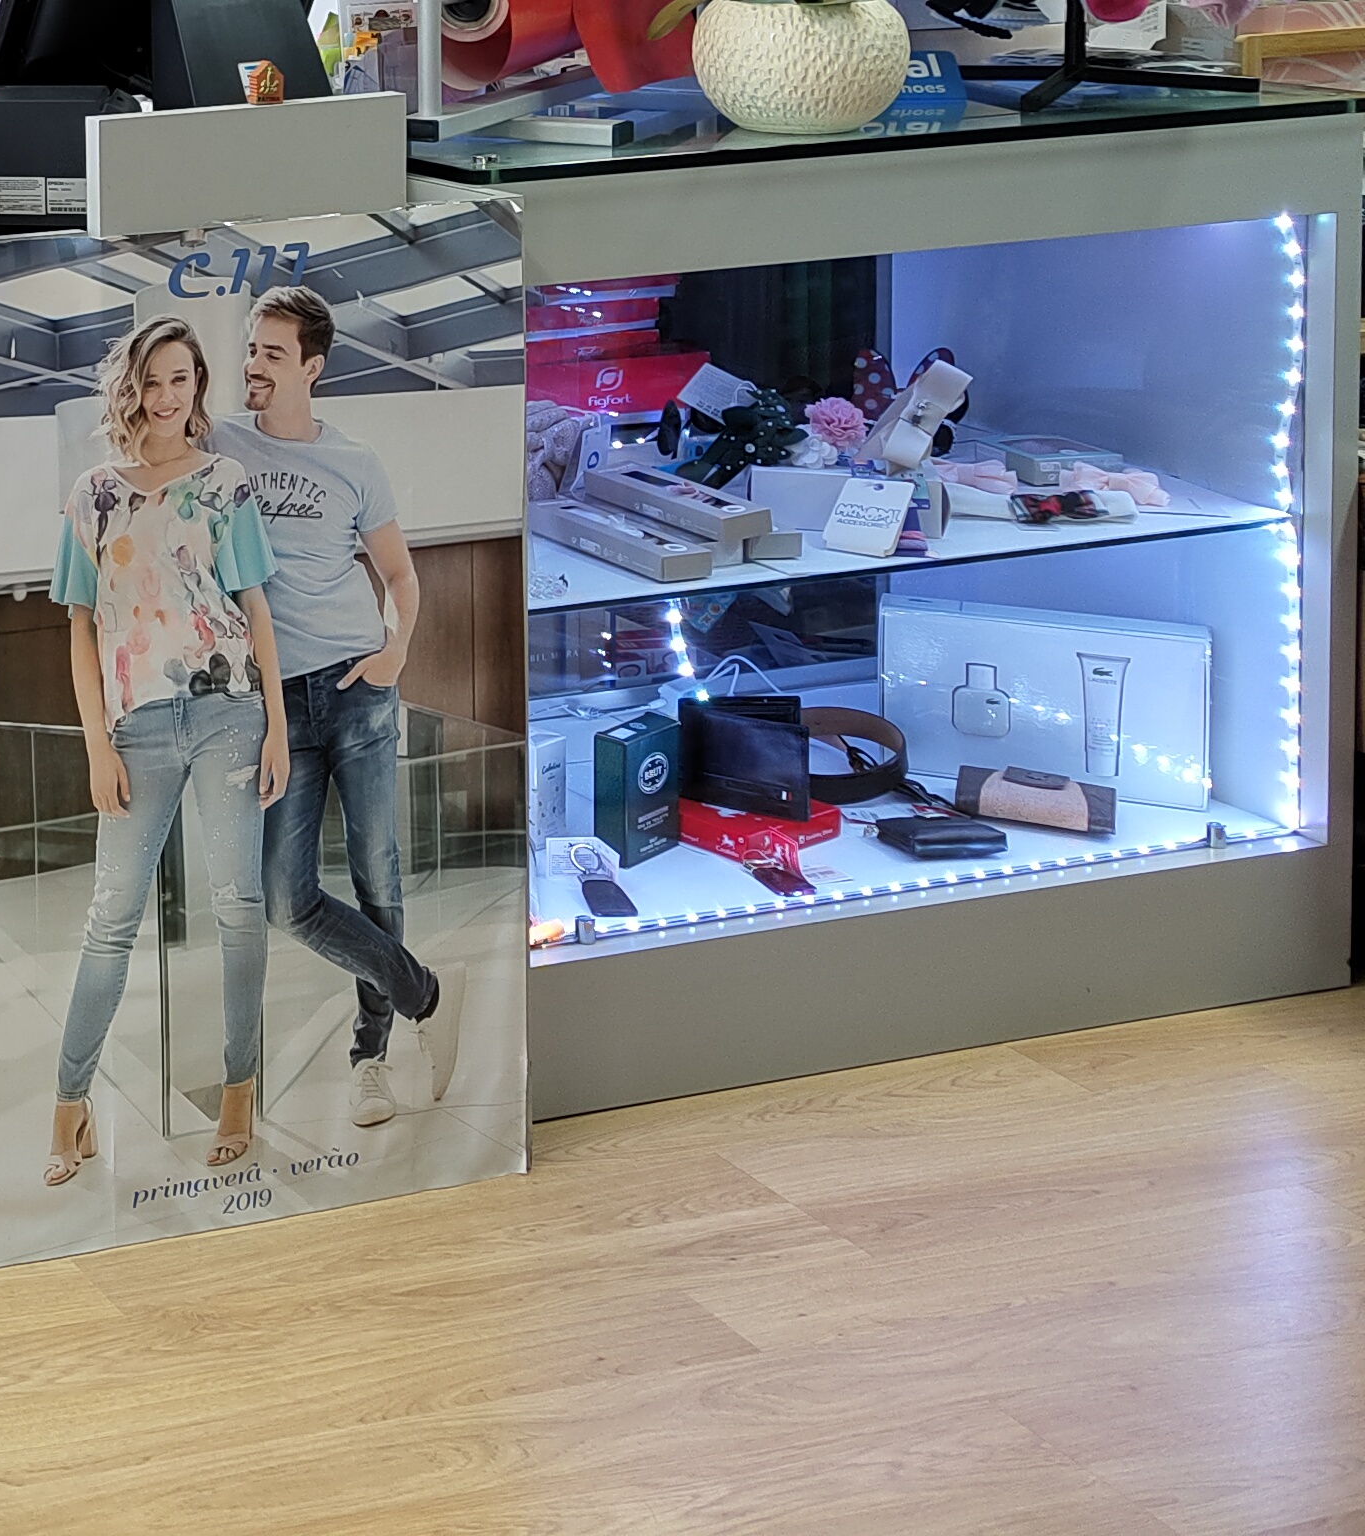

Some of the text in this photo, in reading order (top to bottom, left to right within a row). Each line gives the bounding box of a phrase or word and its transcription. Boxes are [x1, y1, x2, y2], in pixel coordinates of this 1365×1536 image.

[168, 241, 310, 299] C.117
[588, 392, 632, 410] figfort
[249, 471, 327, 504] UTHENTIC
[133, 1146, 360, 1209] primavera verão
[222, 1189, 273, 1216] 2019
